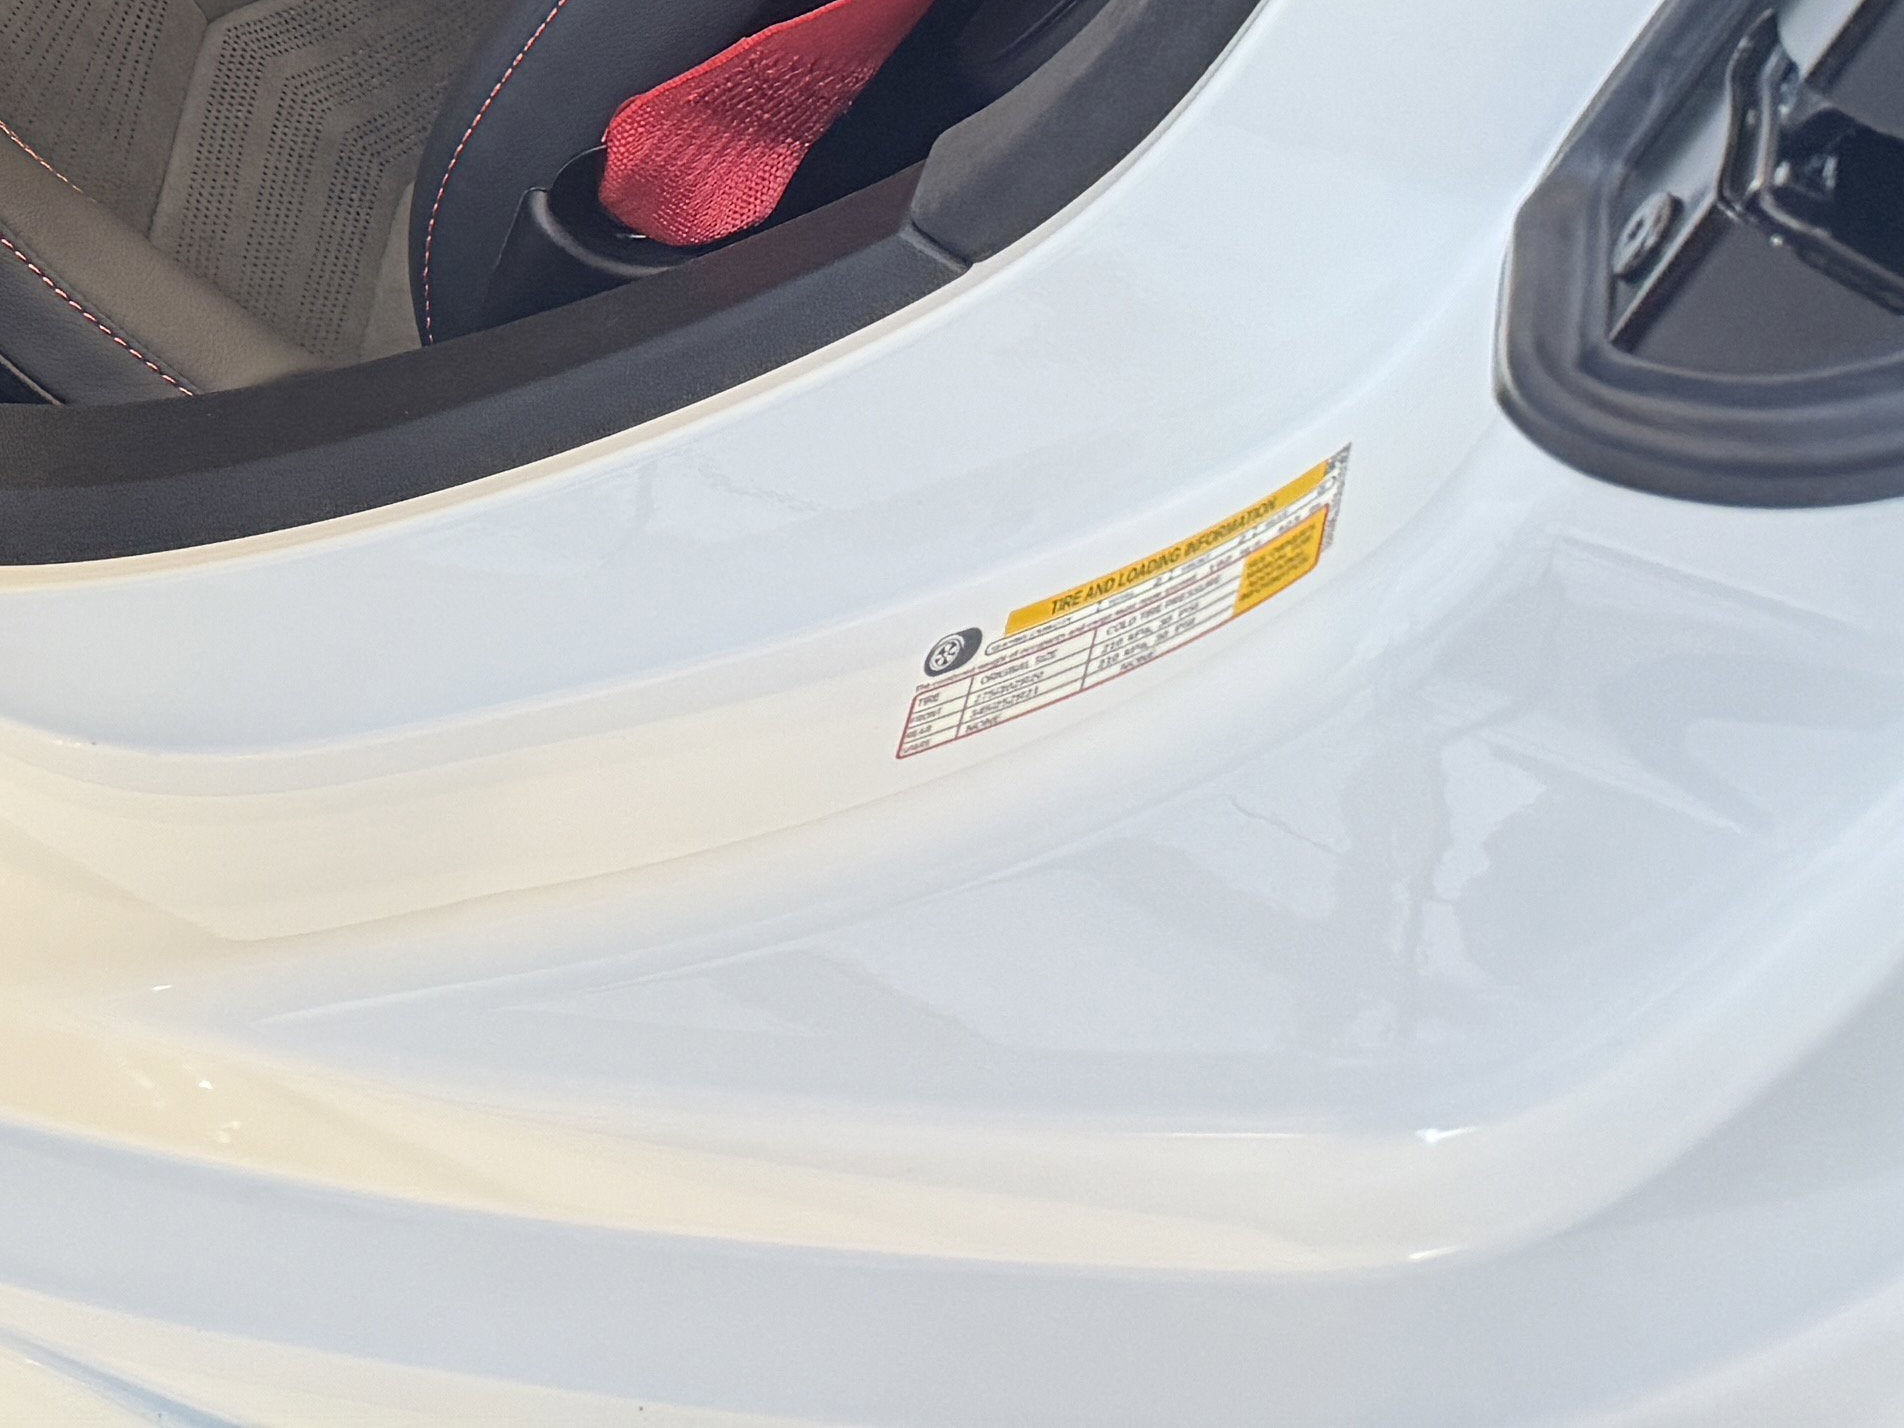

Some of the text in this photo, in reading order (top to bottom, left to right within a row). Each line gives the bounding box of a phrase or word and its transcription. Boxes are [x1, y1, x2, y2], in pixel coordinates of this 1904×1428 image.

[1051, 590, 1084, 616] TIRE
[1085, 576, 1115, 600] AND
[1118, 548, 1182, 588] LOADING
[1183, 499, 1277, 557] INFORMATION
[1106, 615, 1138, 636] COLD
